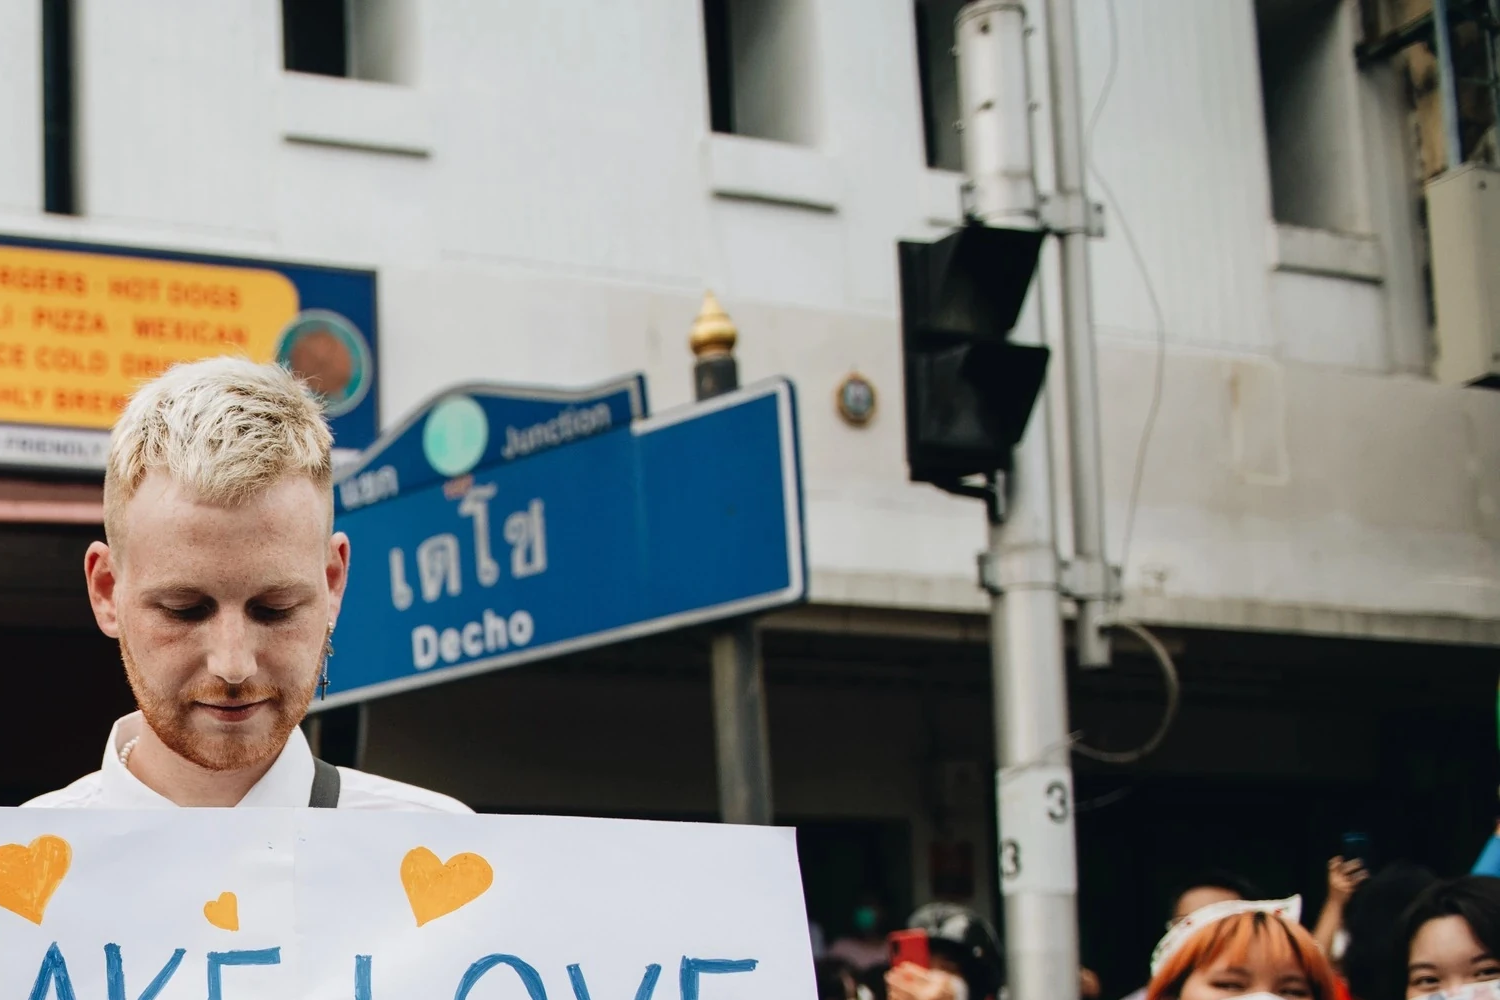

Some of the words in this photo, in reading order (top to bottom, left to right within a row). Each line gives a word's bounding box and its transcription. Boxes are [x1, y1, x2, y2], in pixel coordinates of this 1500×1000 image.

[108, 276, 160, 303] HOT
[166, 280, 242, 310] DOGS
[31, 306, 107, 337] PIZZA
[132, 316, 248, 346] MEXICAN
[33, 347, 109, 376] COLD
[502, 403, 611, 460] Junction
[411, 609, 535, 670] Decho
[1045, 780, 1068, 824] 3
